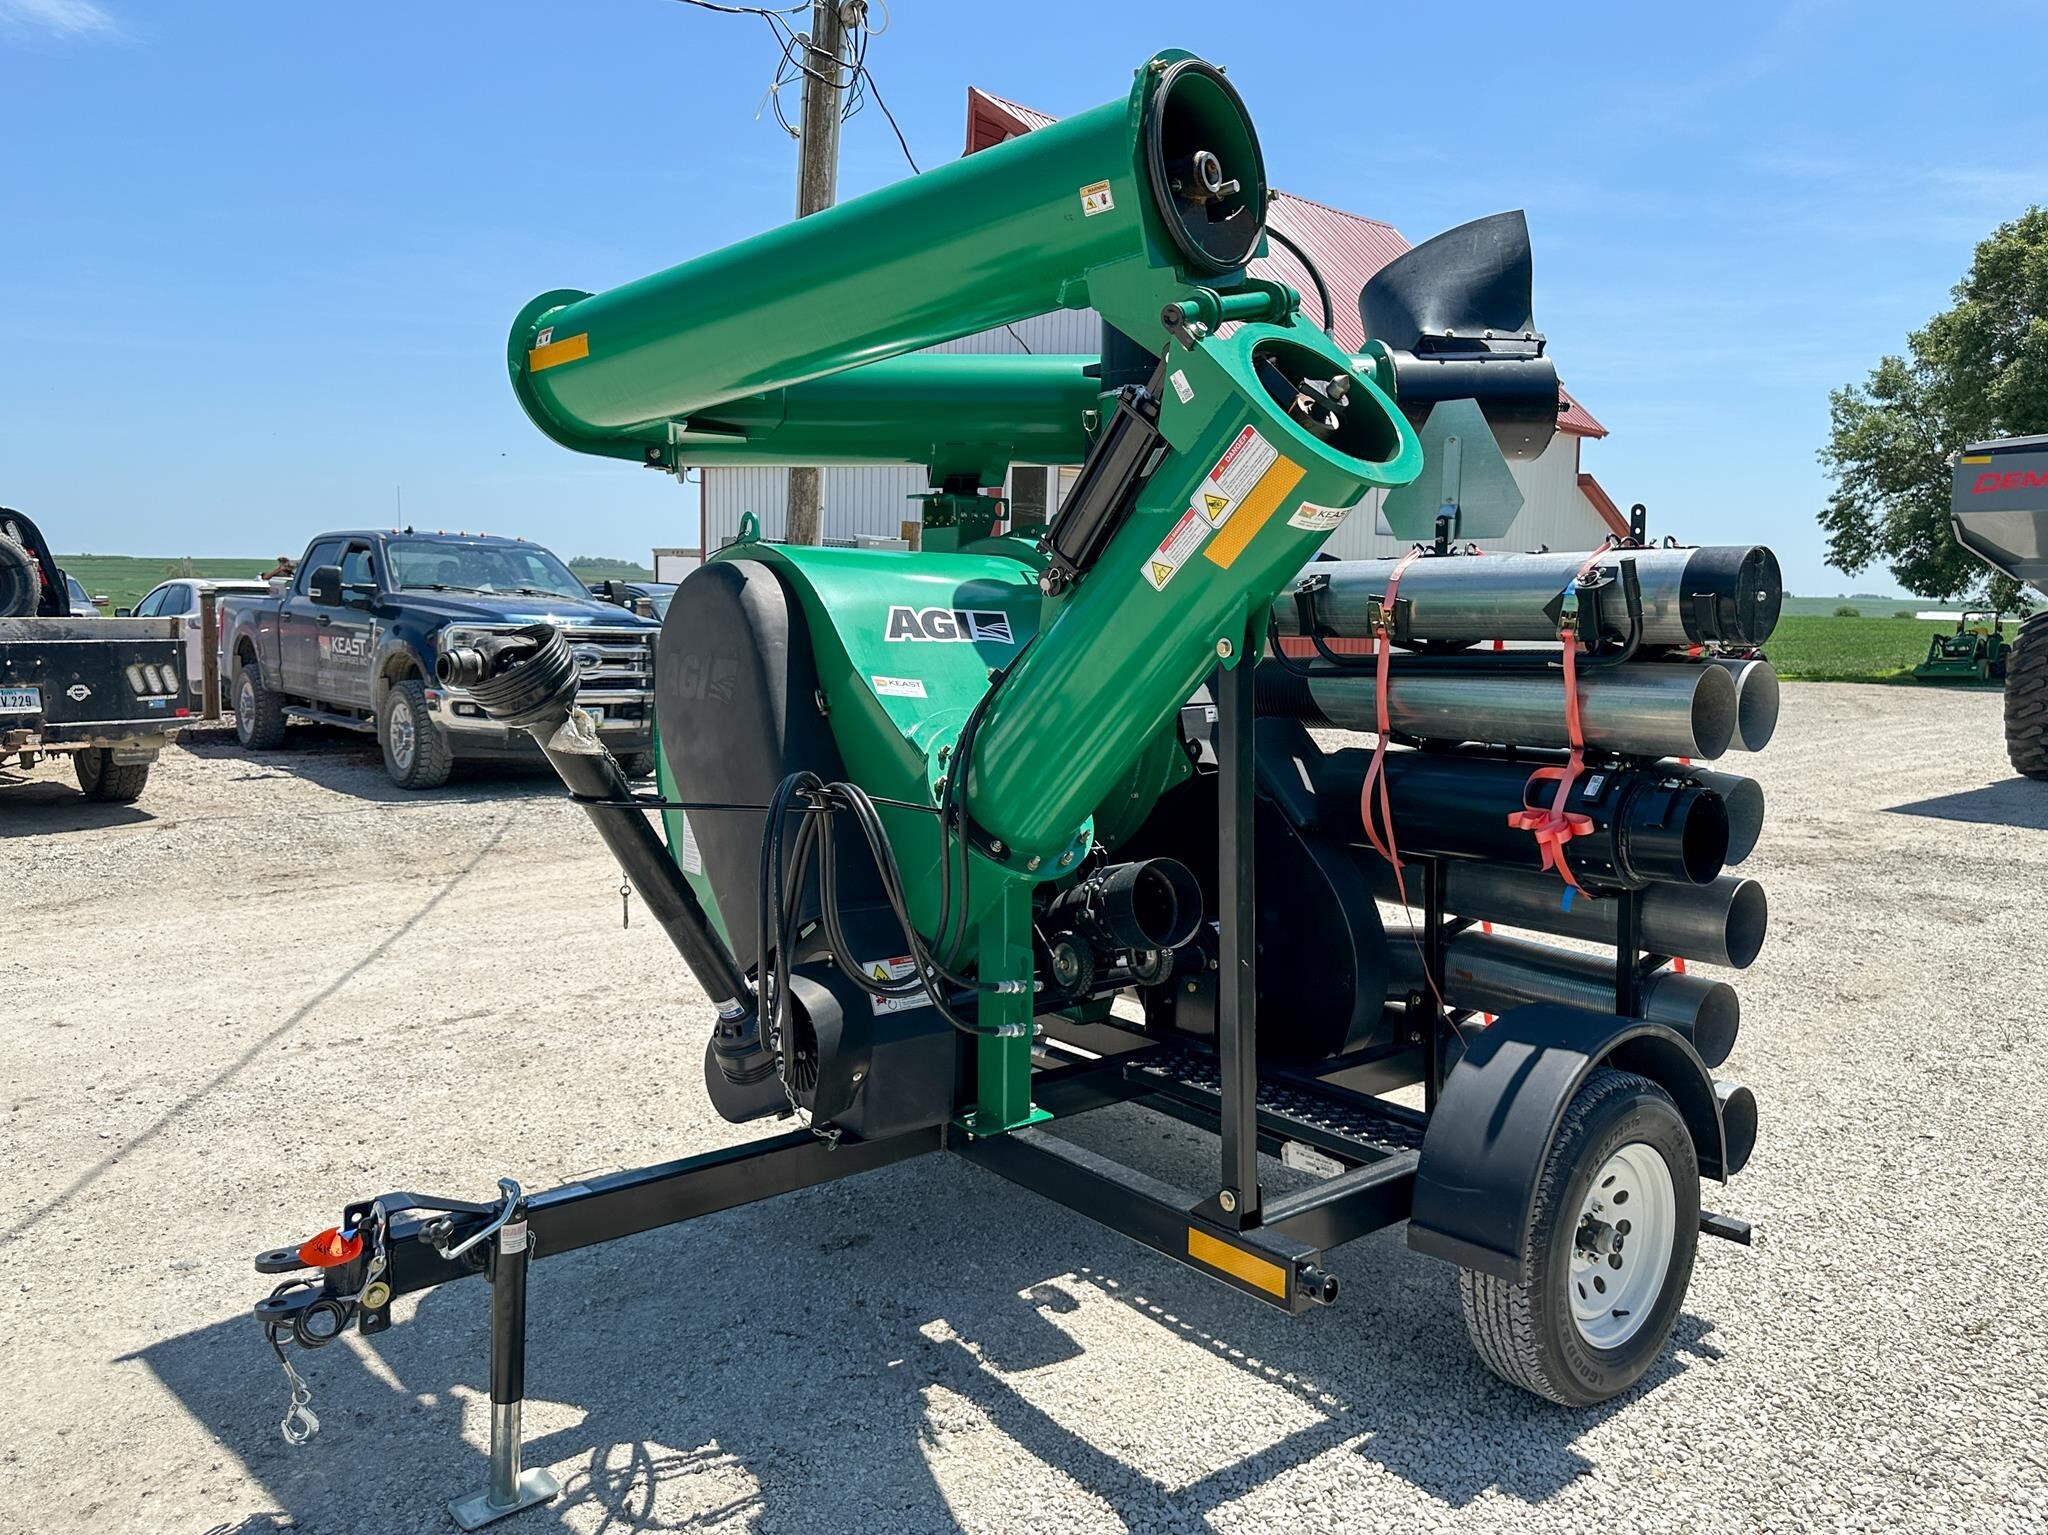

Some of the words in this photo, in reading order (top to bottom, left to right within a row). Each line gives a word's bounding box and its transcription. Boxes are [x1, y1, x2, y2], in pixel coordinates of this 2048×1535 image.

[1225, 433, 1248, 463] DANGER
[1972, 471, 2048, 494] DEM
[889, 608, 973, 640] AGI
[331, 636, 366, 656] KEAST
[11, 695, 31, 707] 229
